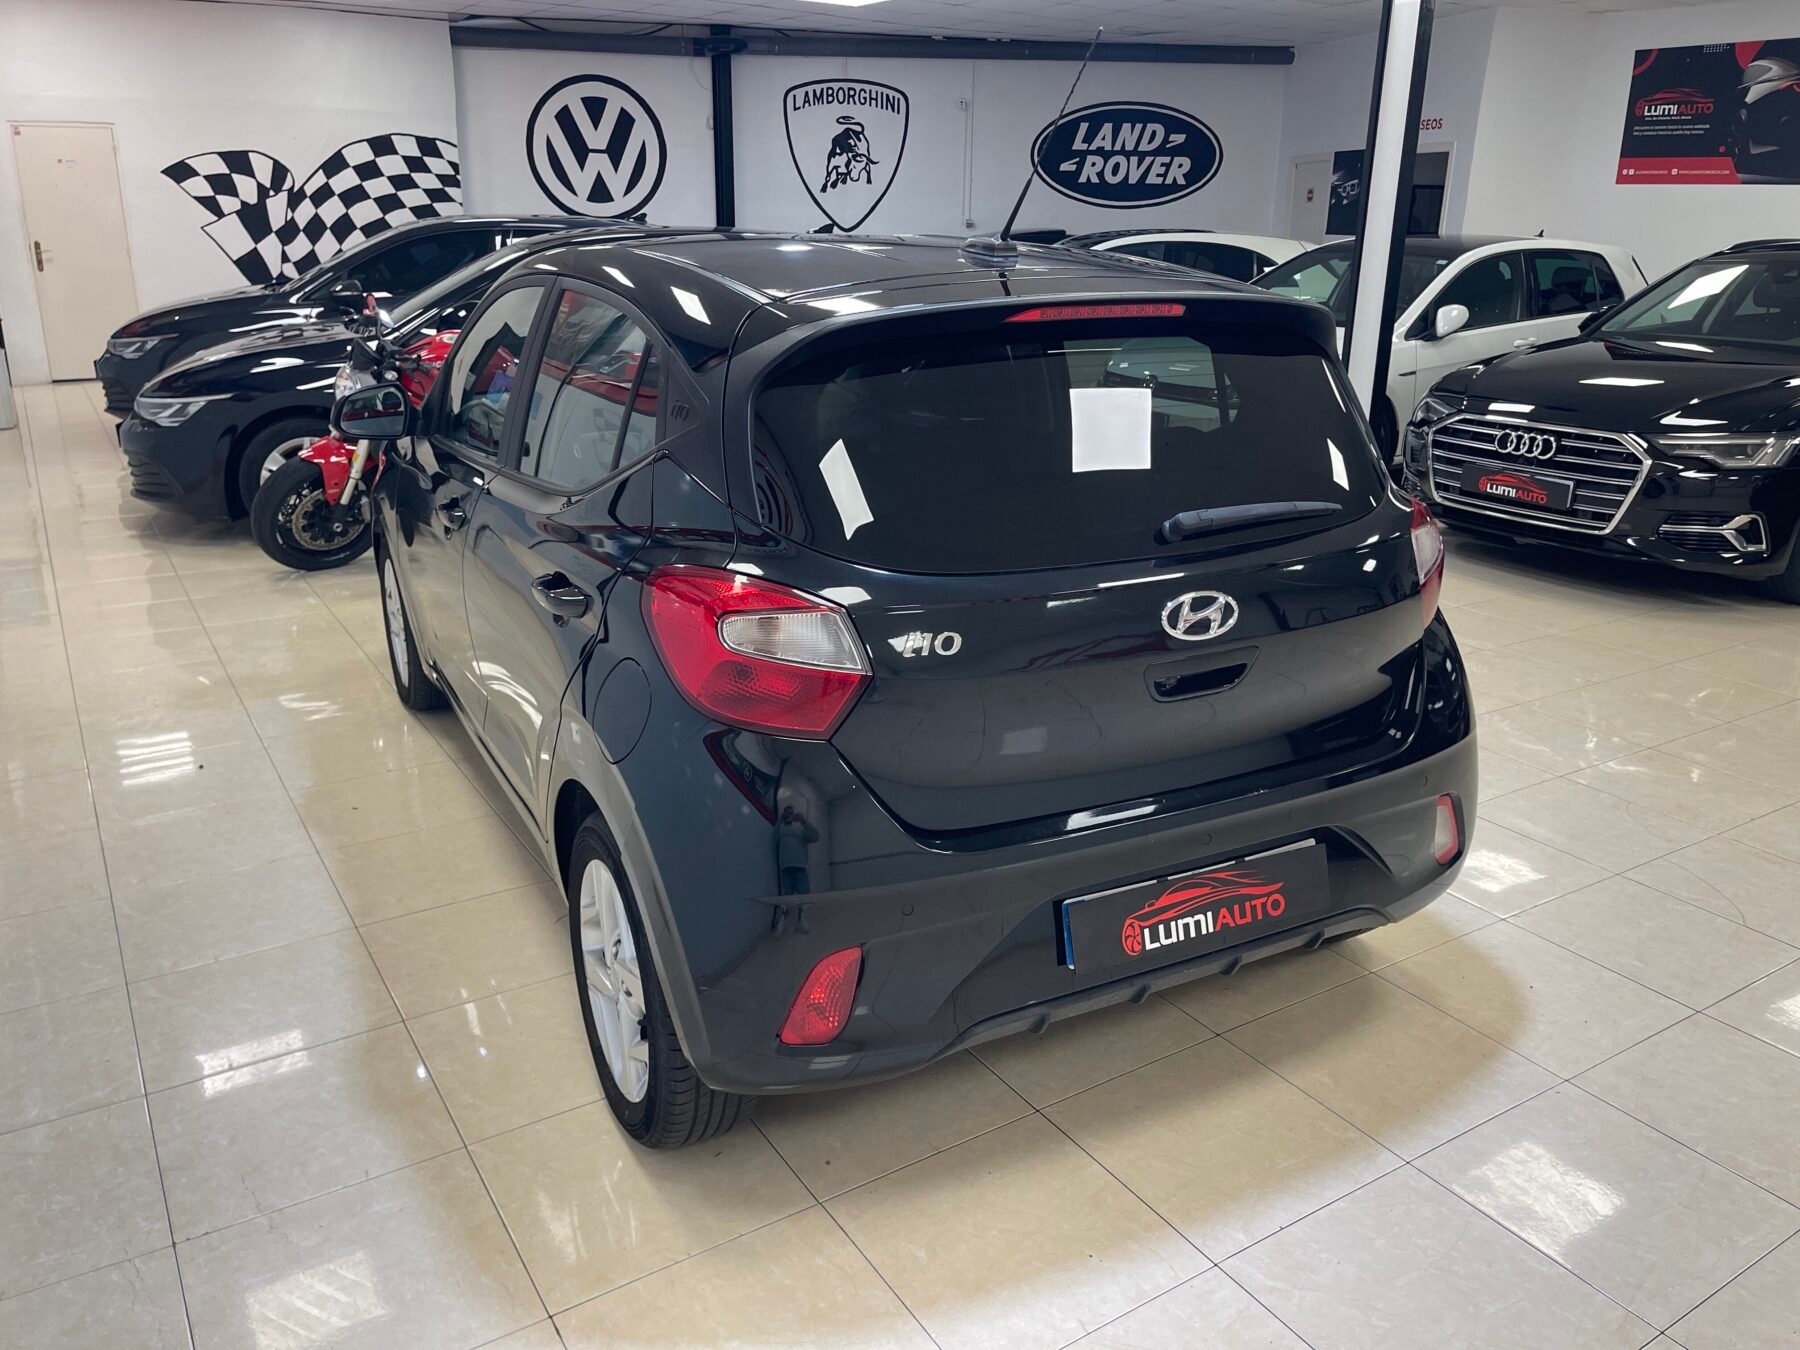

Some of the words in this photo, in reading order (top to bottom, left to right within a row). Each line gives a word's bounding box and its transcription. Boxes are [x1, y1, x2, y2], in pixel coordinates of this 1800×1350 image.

[792, 87, 901, 115] LAMBORGHINI
[1072, 122, 1168, 152] LAND
[1420, 118, 1443, 130] SEOS
[1077, 154, 1192, 185] ROVER
